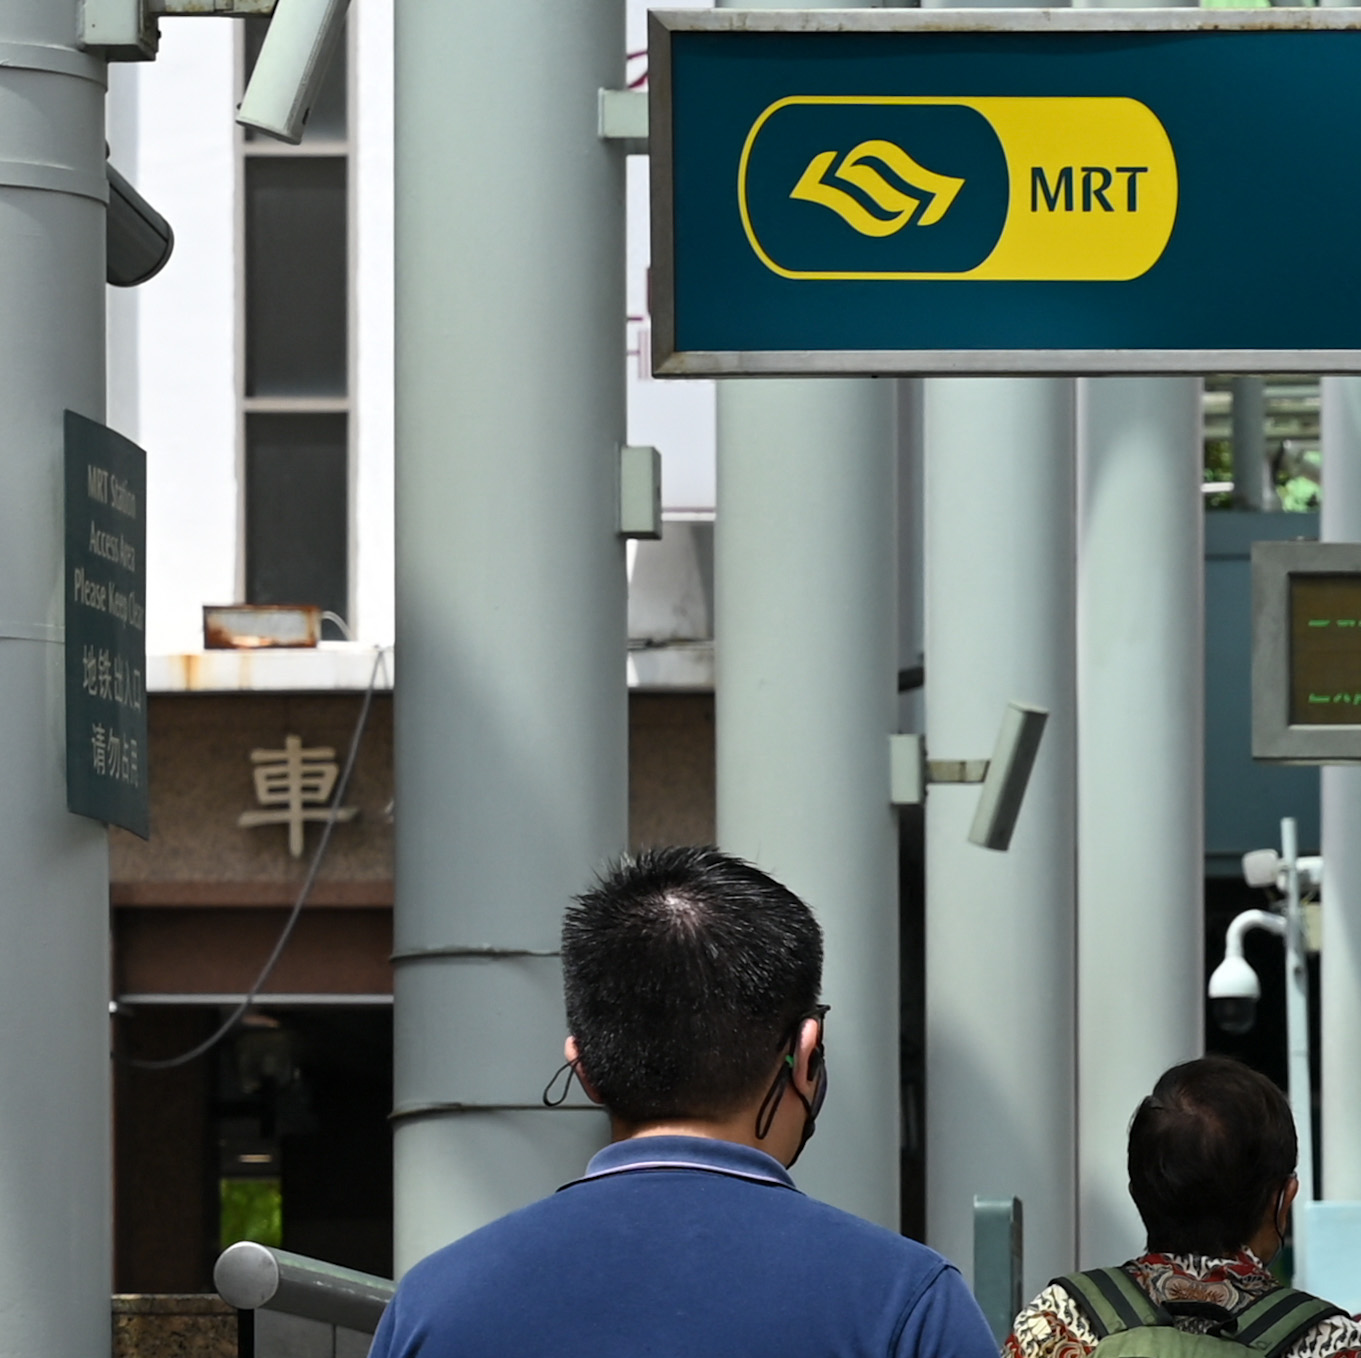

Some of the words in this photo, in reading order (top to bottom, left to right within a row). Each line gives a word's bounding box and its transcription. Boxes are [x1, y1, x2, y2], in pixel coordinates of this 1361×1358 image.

[1030, 166, 1149, 213] MRT
[88, 464, 108, 504] MRT
[110, 473, 136, 519] Station
[89, 520, 119, 562] Access
[119, 533, 136, 573] Area
[74, 567, 106, 612] Please
[107, 579, 128, 629] Keep
[82, 643, 142, 713] 地铁出入口
[91, 721, 139, 789] 请勿占用
[236, 734, 360, 858] 車
